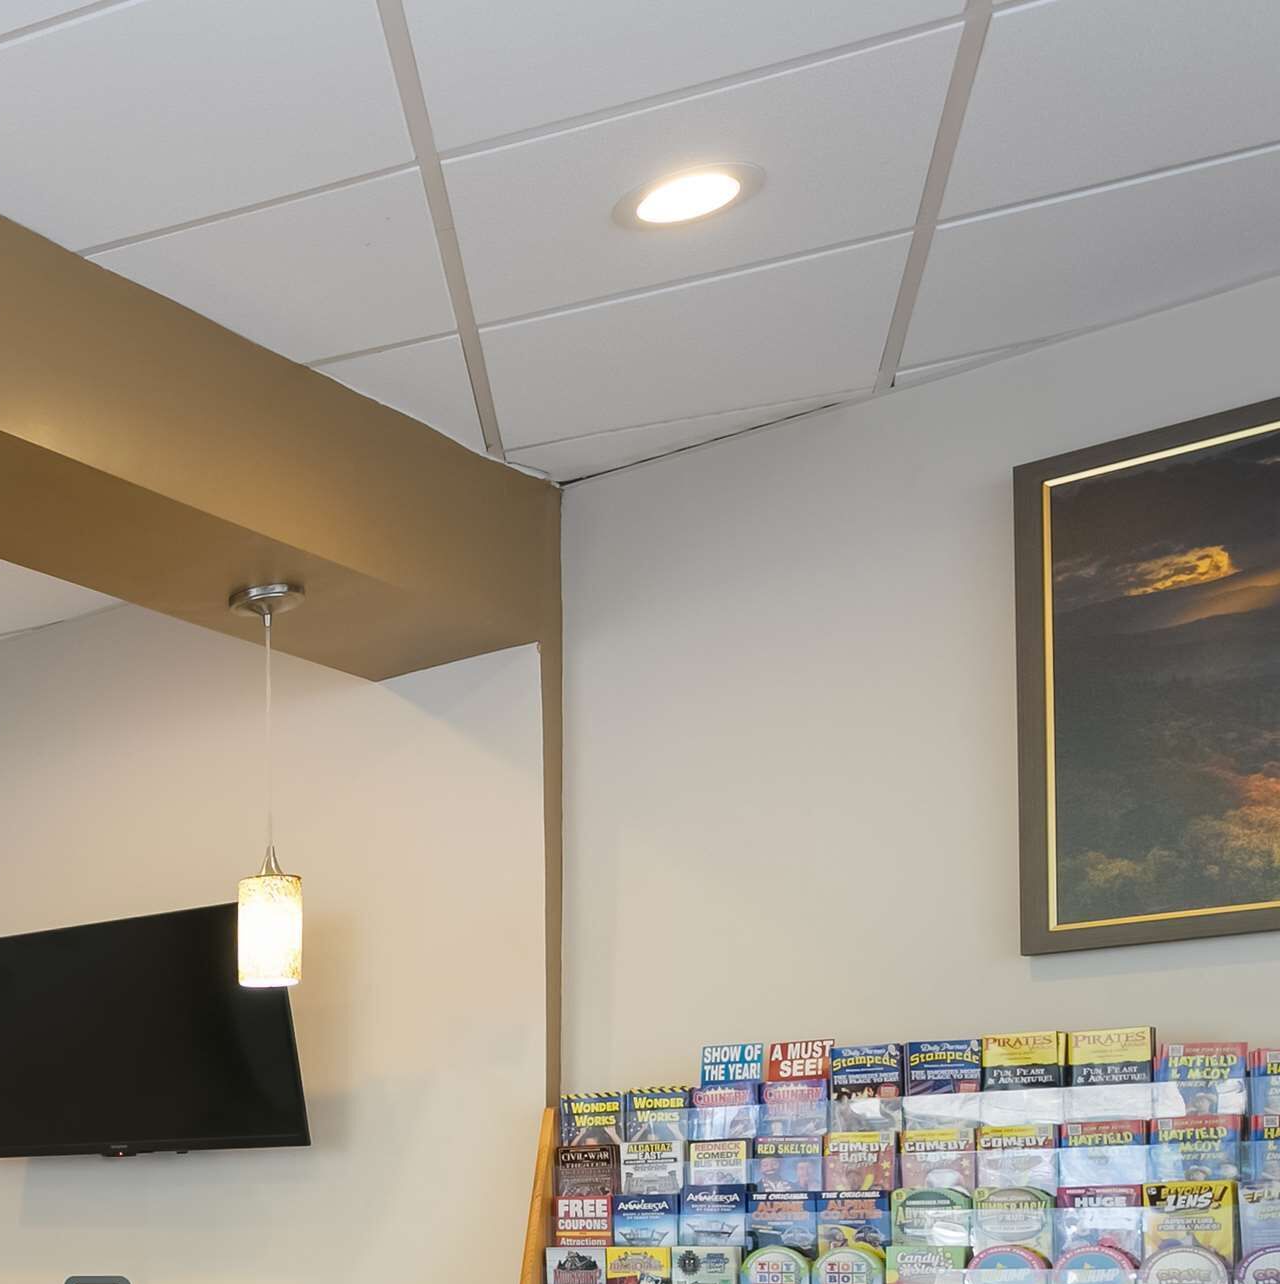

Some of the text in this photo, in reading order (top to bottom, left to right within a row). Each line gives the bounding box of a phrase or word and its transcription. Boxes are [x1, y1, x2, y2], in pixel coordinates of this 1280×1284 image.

[984, 1034, 1053, 1052] PIRATES
[1073, 1031, 1147, 1049] PIRATES
[703, 1044, 762, 1063] SHOW OF
[771, 1040, 834, 1059] A MUST
[1168, 1054, 1237, 1067] HATFIELD
[703, 1061, 761, 1081] THE YEAR!
[779, 1058, 823, 1077] SEE!
[571, 1102, 619, 1113] WONDER
[633, 1097, 684, 1109] WONDER
[574, 1115, 616, 1127] WORKS
[637, 1110, 679, 1122] WORKS
[1158, 1127, 1227, 1142] HATFIELD
[627, 1143, 672, 1153] ALCATRAZ
[757, 1143, 820, 1154] RED SKELTON
[829, 1142, 889, 1152] COMEDY
[904, 1140, 968, 1152] COMEDY
[638, 1151, 662, 1160] EAST
[696, 1151, 740, 1160] COMEDY
[558, 1199, 608, 1218] FREE
[558, 1219, 608, 1230] COUPONS
[897, 1251, 940, 1266] Candy
